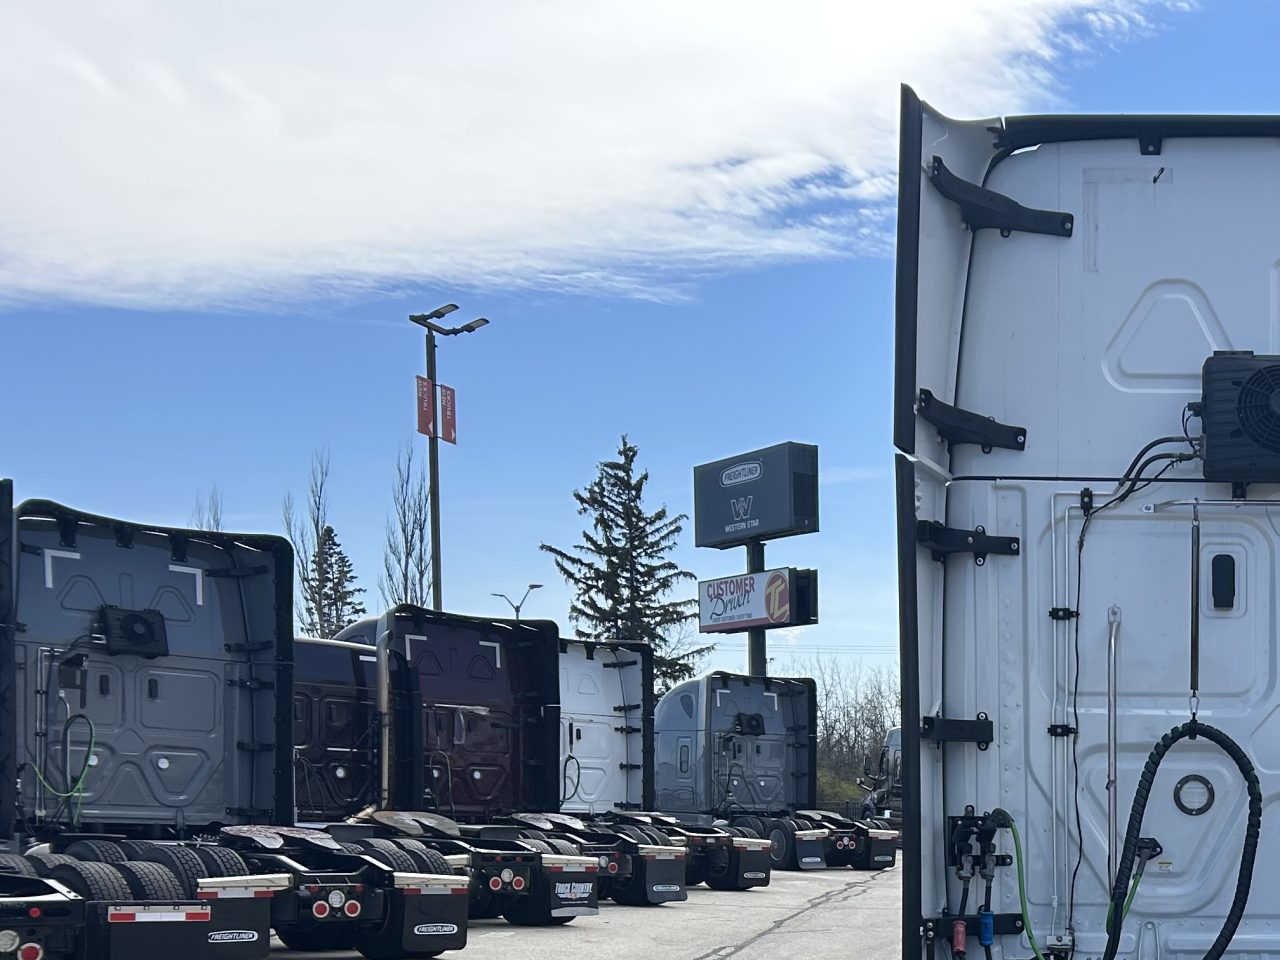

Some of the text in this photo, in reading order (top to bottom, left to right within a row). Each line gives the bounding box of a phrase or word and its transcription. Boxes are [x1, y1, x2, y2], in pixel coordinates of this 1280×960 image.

[725, 519, 759, 532] WESTERN STAR
[707, 576, 755, 599] CUSTOMER
[710, 590, 750, 620] Driven
[210, 932, 254, 940] FREIGHTLINER
